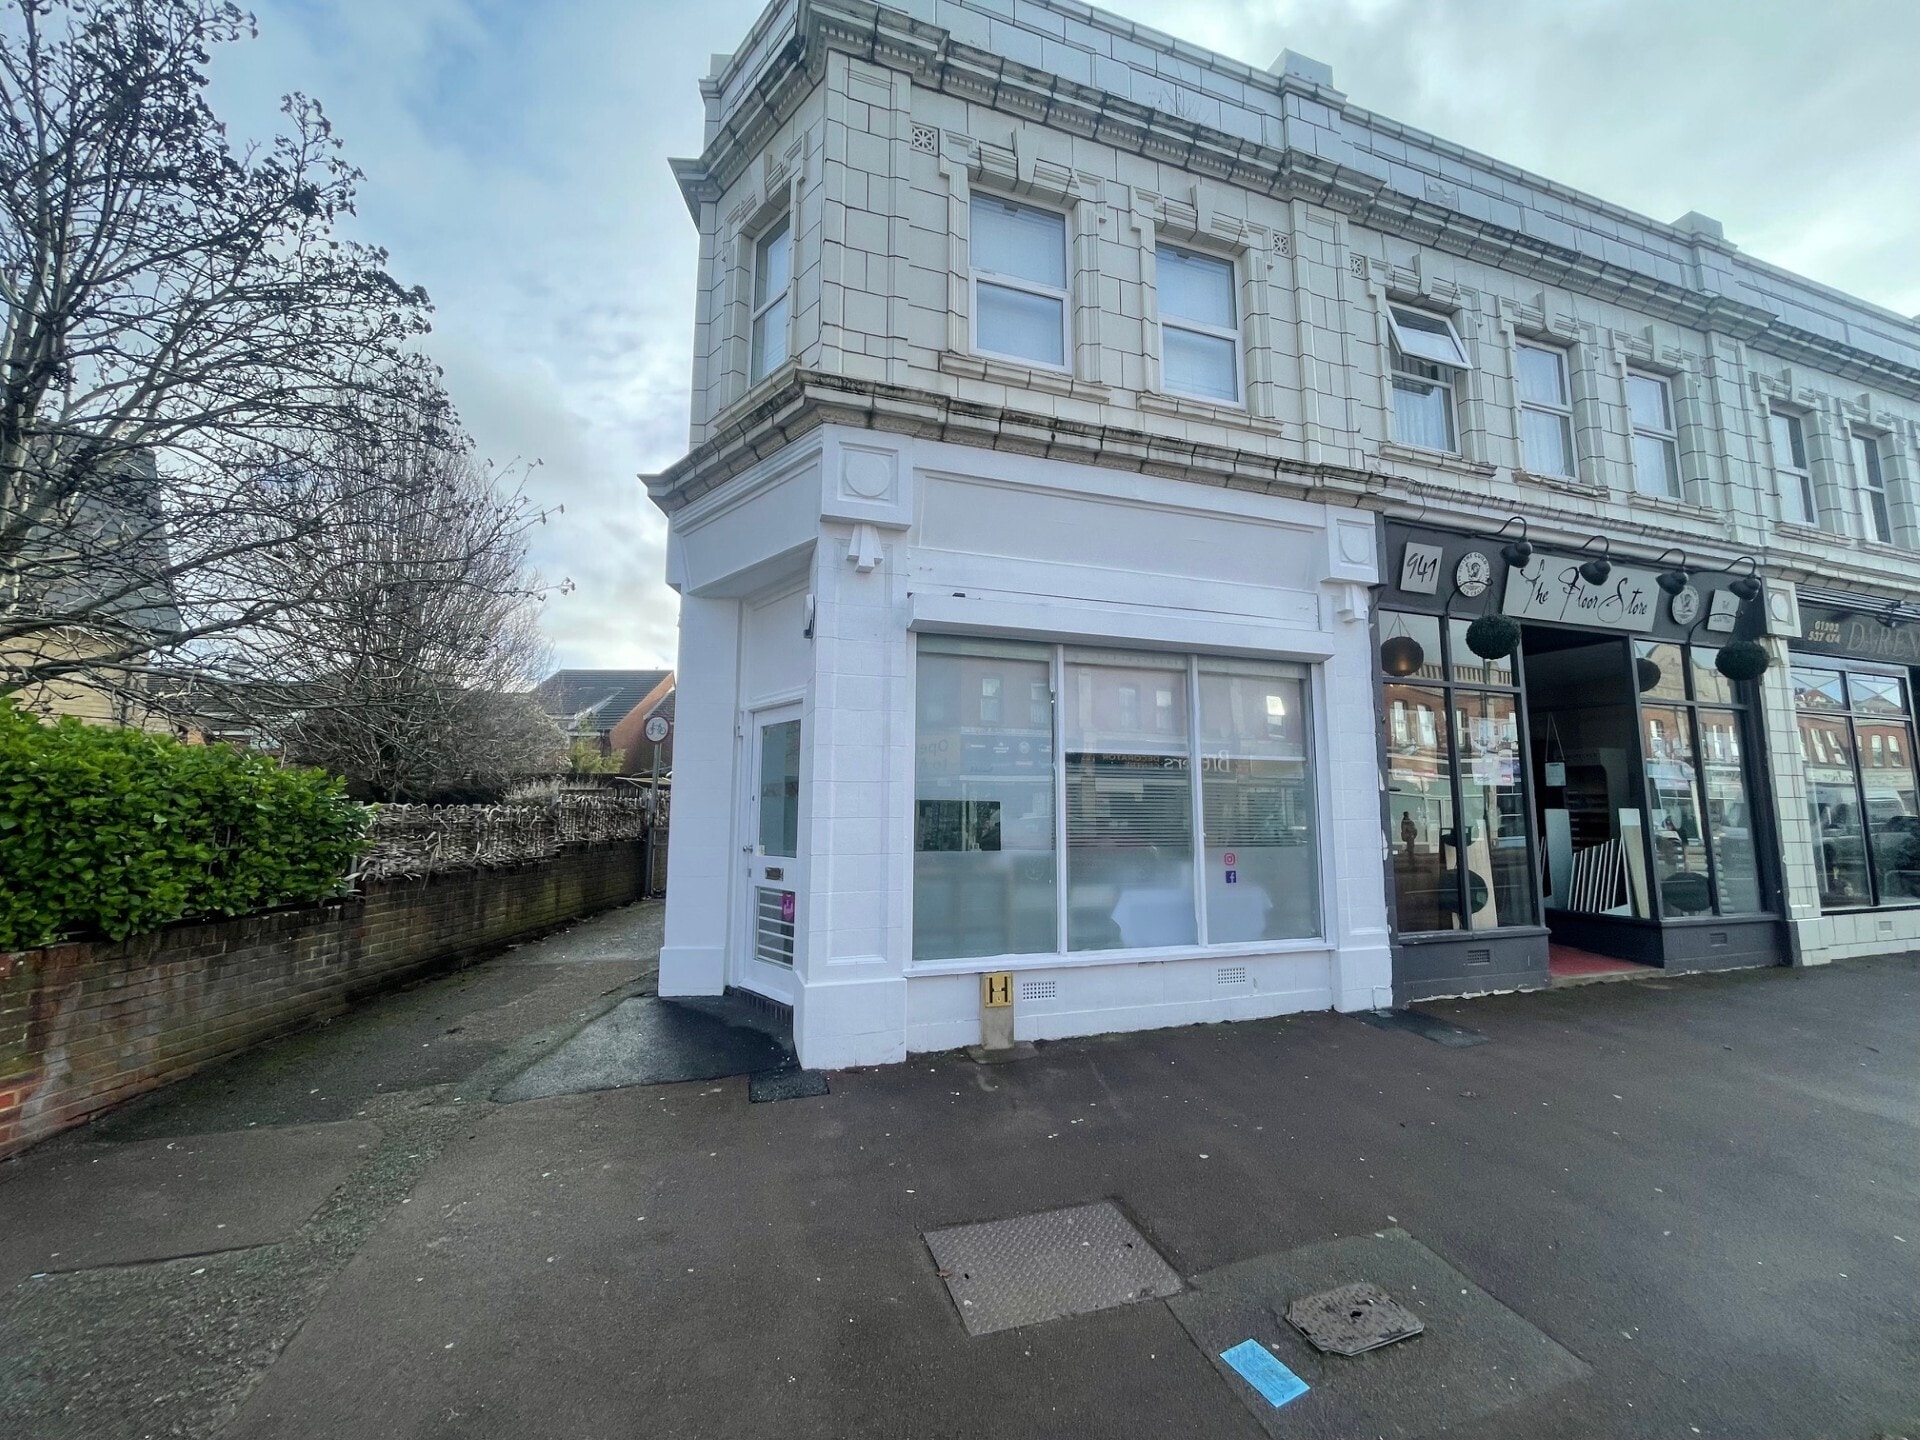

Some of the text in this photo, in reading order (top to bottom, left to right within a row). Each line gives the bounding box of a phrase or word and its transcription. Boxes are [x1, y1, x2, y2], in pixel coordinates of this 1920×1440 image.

[1406, 552, 1438, 583] 941
[1519, 558, 1549, 614] The
[1557, 566, 1599, 620] Floor
[1597, 577, 1648, 624] Store
[989, 976, 1008, 1004] H
